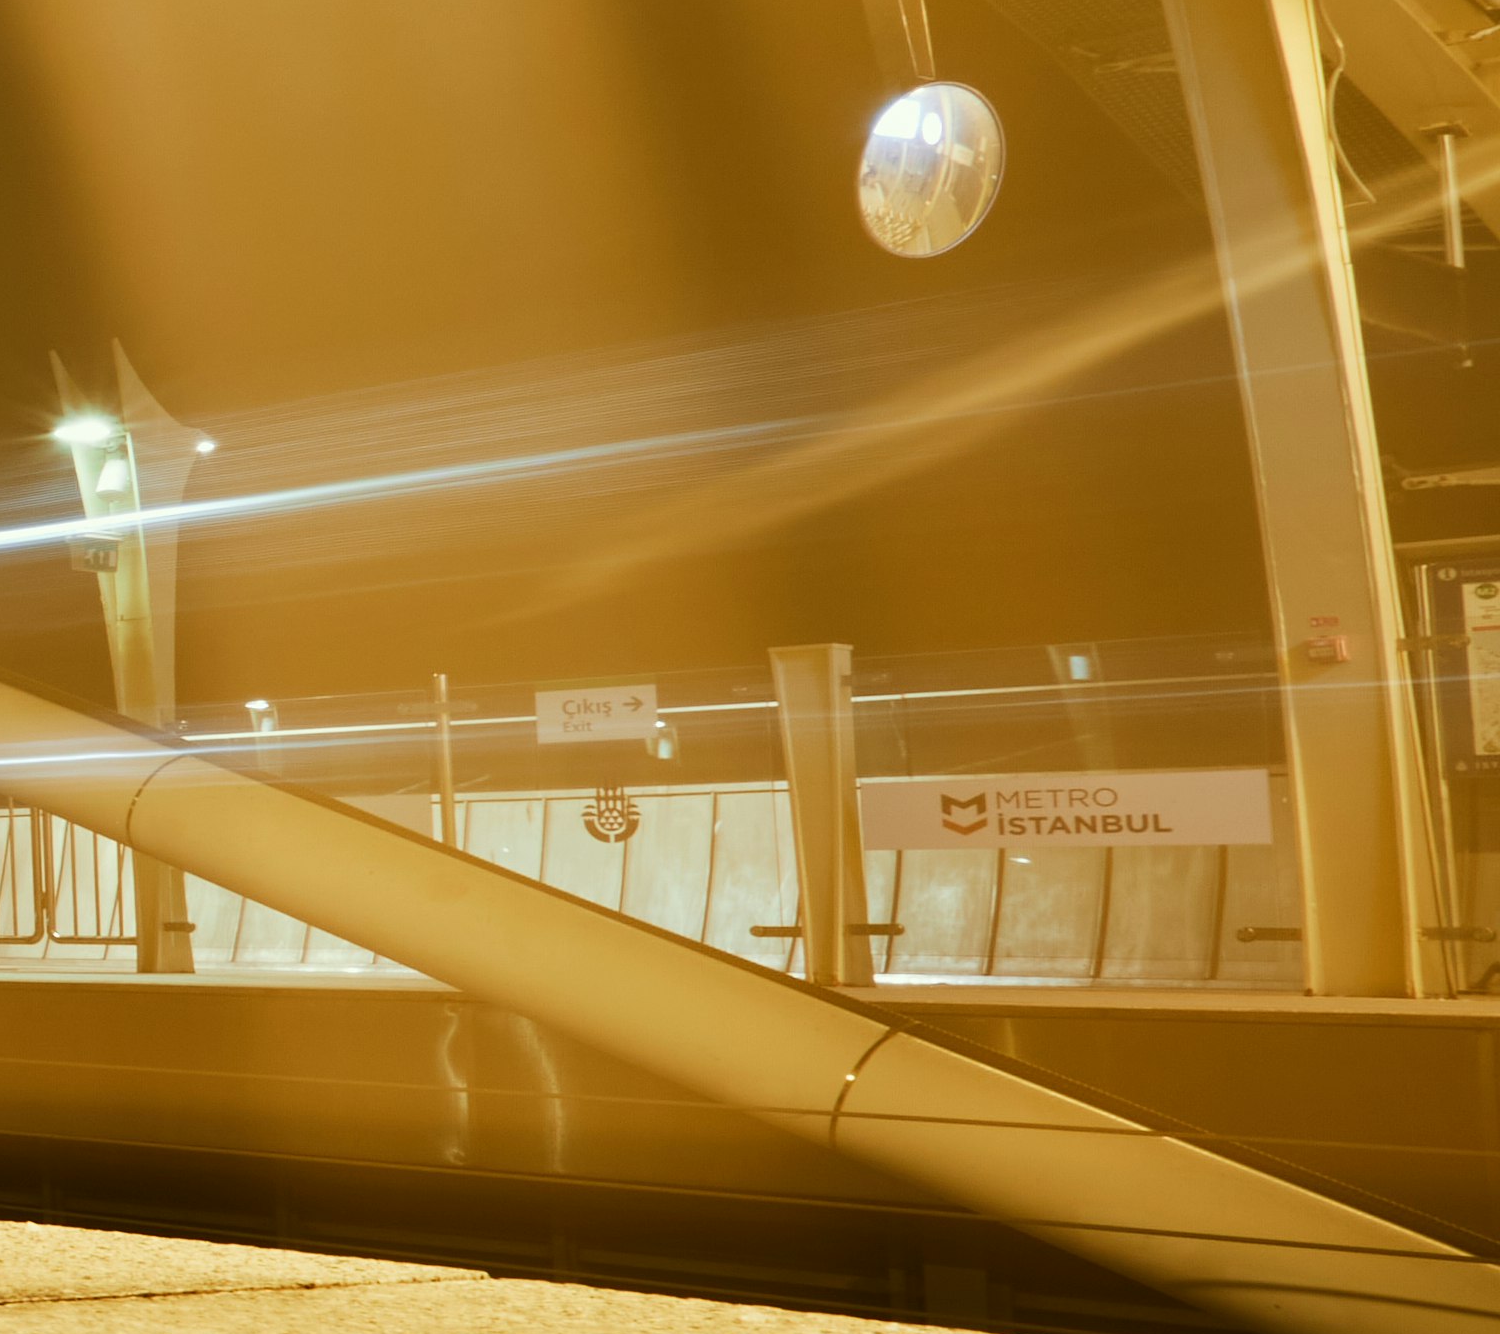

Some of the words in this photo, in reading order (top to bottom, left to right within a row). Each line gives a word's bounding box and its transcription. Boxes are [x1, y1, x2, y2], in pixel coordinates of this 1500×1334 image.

[562, 698, 612, 718] Çıkış
[563, 721, 593, 733] Exit
[996, 787, 1118, 809] METRO
[998, 813, 1173, 836] İSTANBUL
